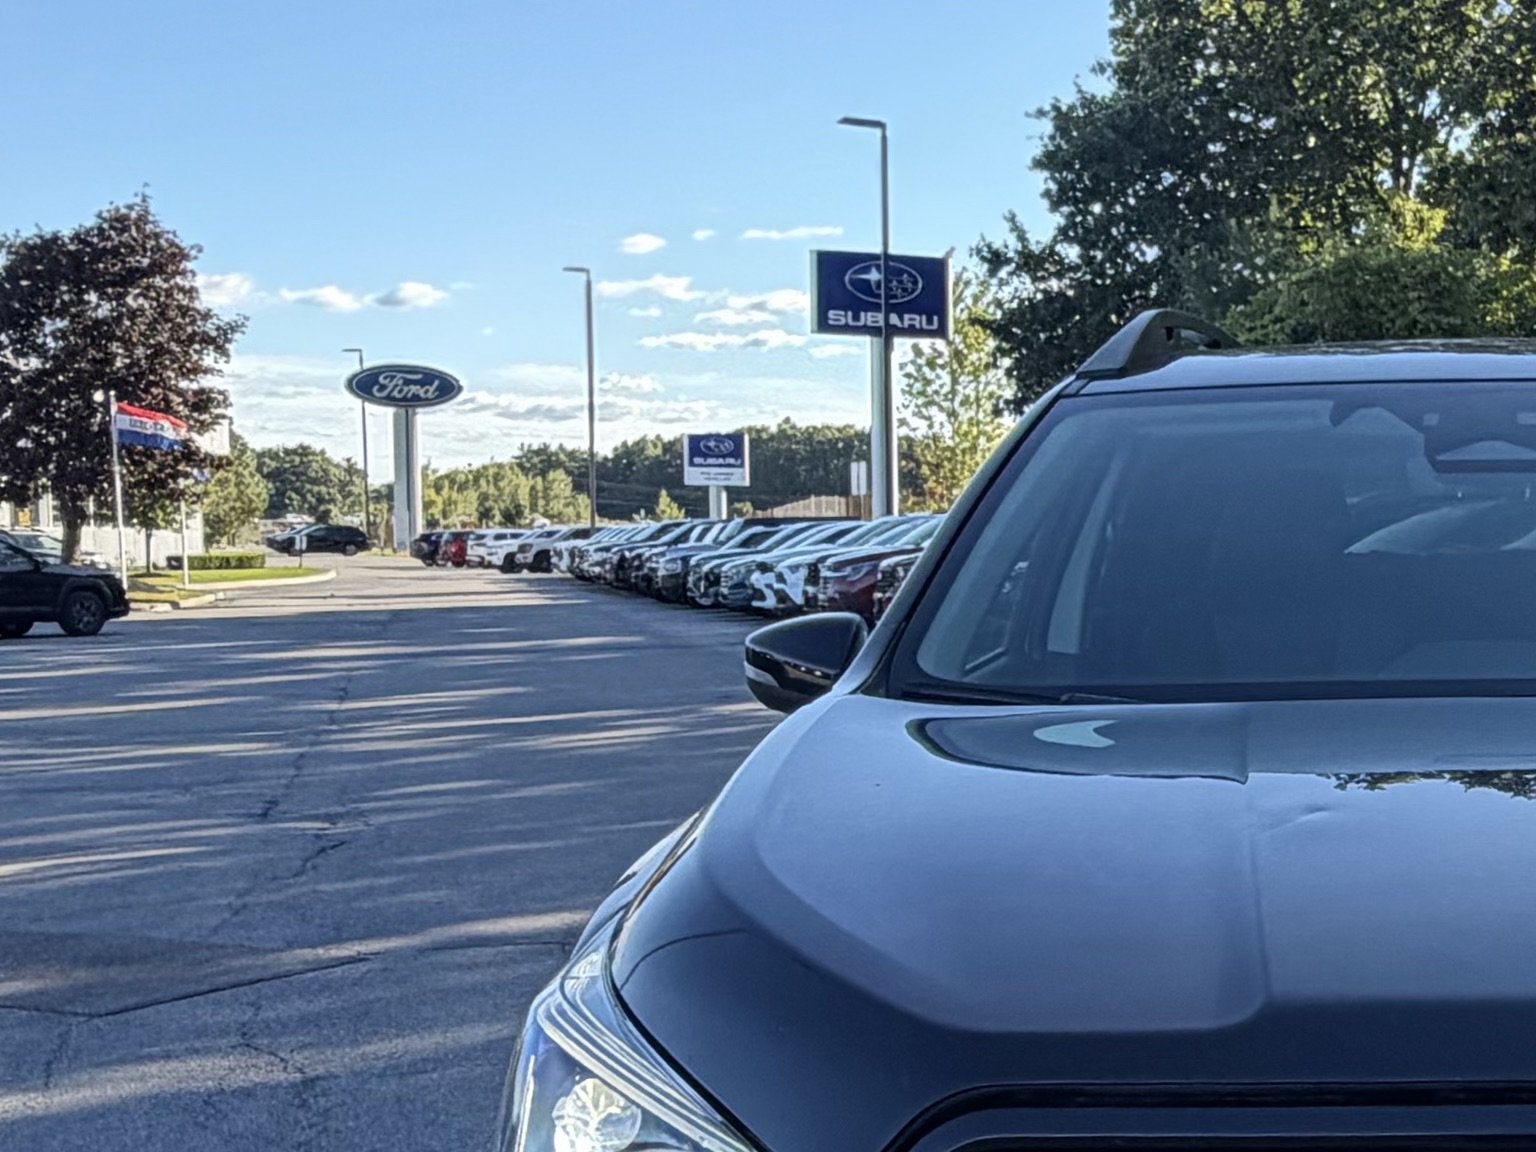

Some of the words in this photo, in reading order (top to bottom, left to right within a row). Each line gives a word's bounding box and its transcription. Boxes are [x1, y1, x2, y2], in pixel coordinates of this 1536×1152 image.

[827, 309, 939, 330] SUBARU
[372, 371, 440, 399] Ford
[692, 456, 742, 466] SUBARU
